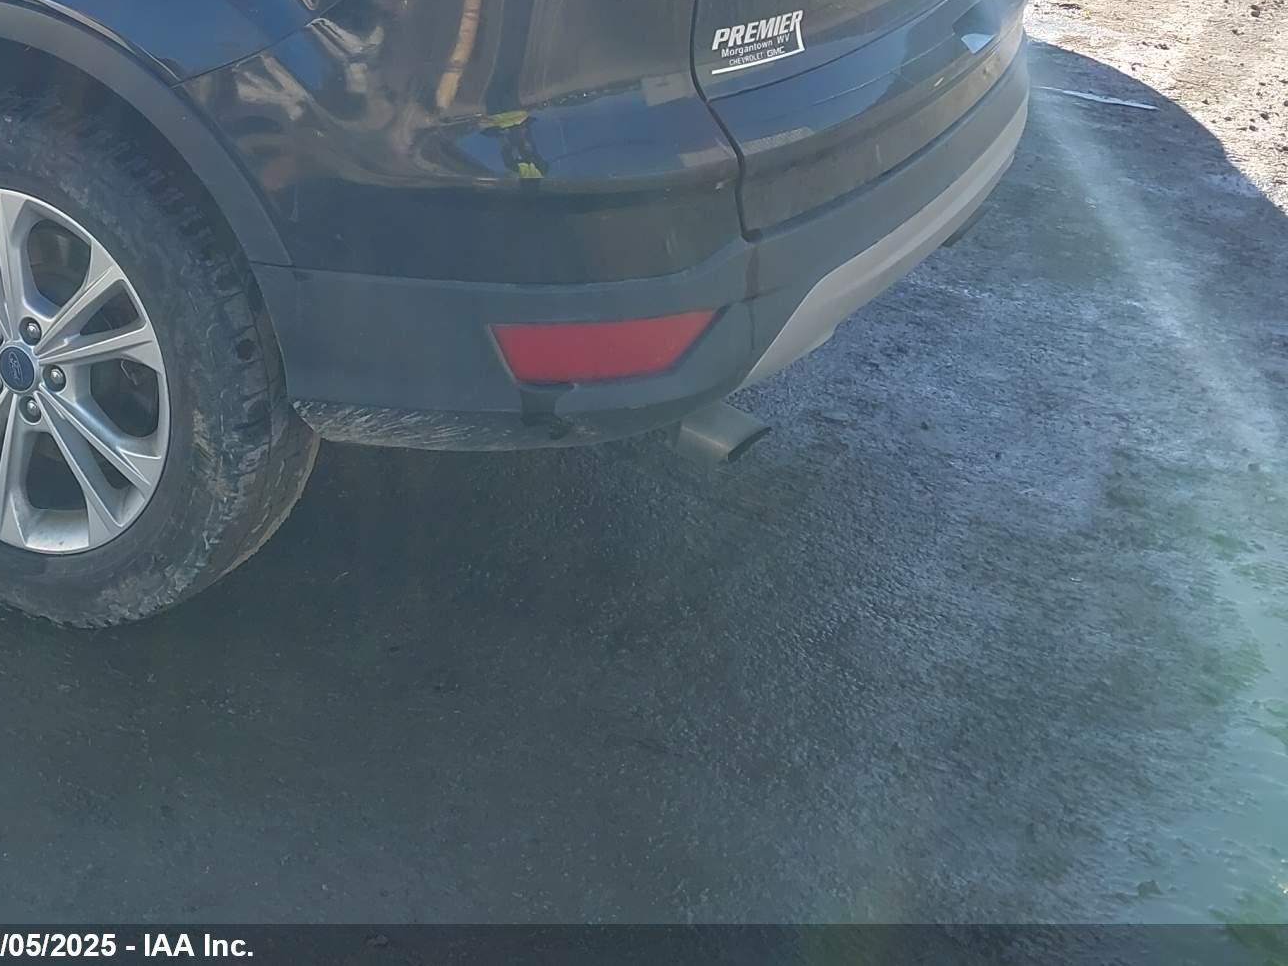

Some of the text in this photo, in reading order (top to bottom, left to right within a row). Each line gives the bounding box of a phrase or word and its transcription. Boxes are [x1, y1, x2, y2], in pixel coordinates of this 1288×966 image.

[712, 10, 804, 51] PREMIER
[721, 34, 791, 59] Morgantown WV
[728, 46, 786, 66] CHEVROLET GMC
